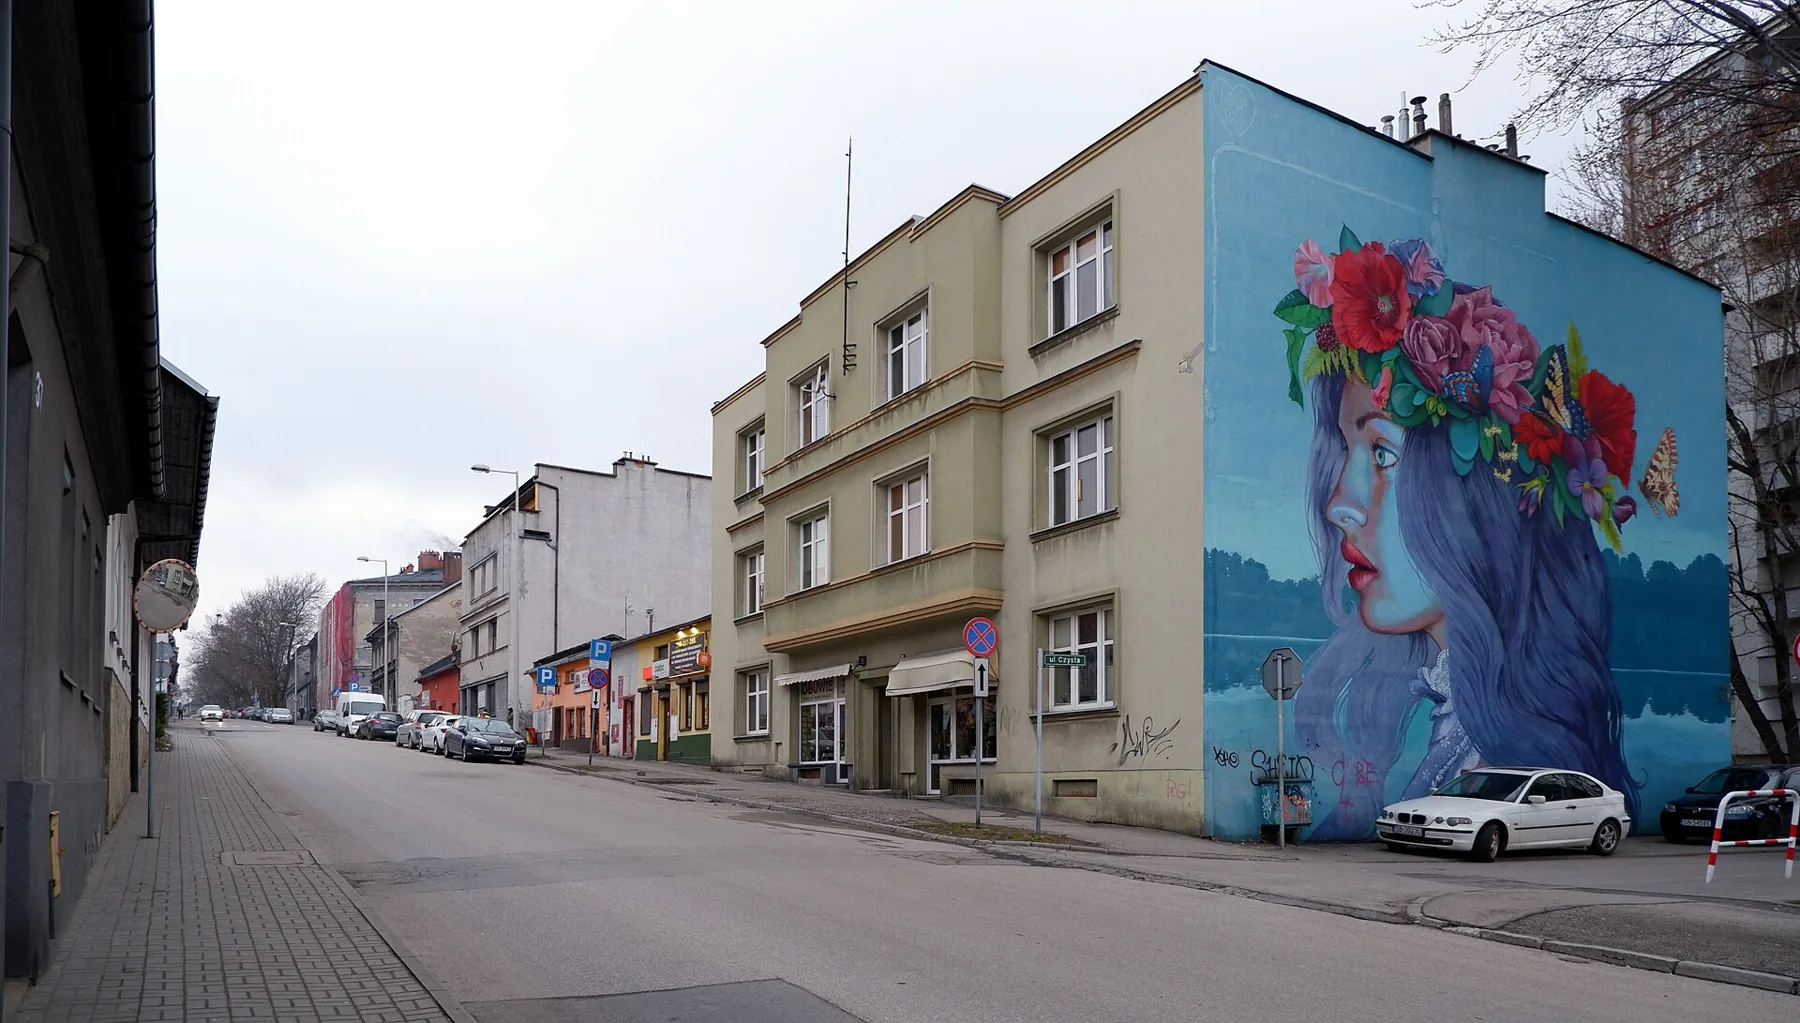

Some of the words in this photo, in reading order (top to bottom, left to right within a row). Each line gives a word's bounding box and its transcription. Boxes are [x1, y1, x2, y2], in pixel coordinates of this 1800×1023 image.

[35, 371, 44, 417] 37
[594, 642, 607, 657] P
[1058, 656, 1081, 664] Czysta
[541, 669, 553, 683] P
[802, 679, 834, 695] OBUWIE
